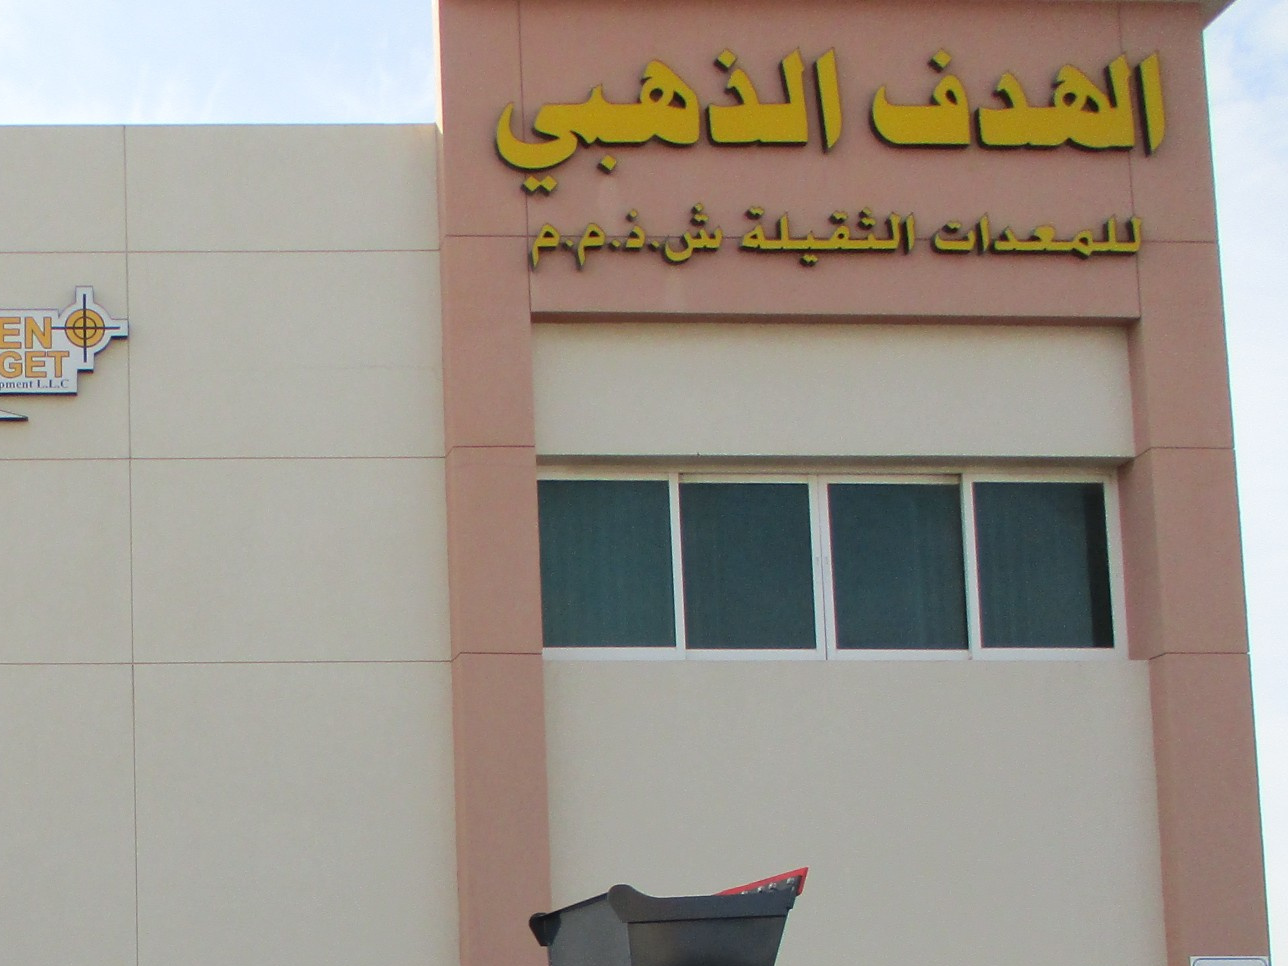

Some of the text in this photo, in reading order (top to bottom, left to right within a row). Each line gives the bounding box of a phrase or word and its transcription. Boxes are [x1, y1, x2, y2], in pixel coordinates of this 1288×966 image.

[495, 46, 1166, 195] الهدف الذهبي
[739, 206, 915, 267] الثقيلة
[931, 212, 1143, 259] للمعدات
[36, 379, 69, 389] L.L.C
